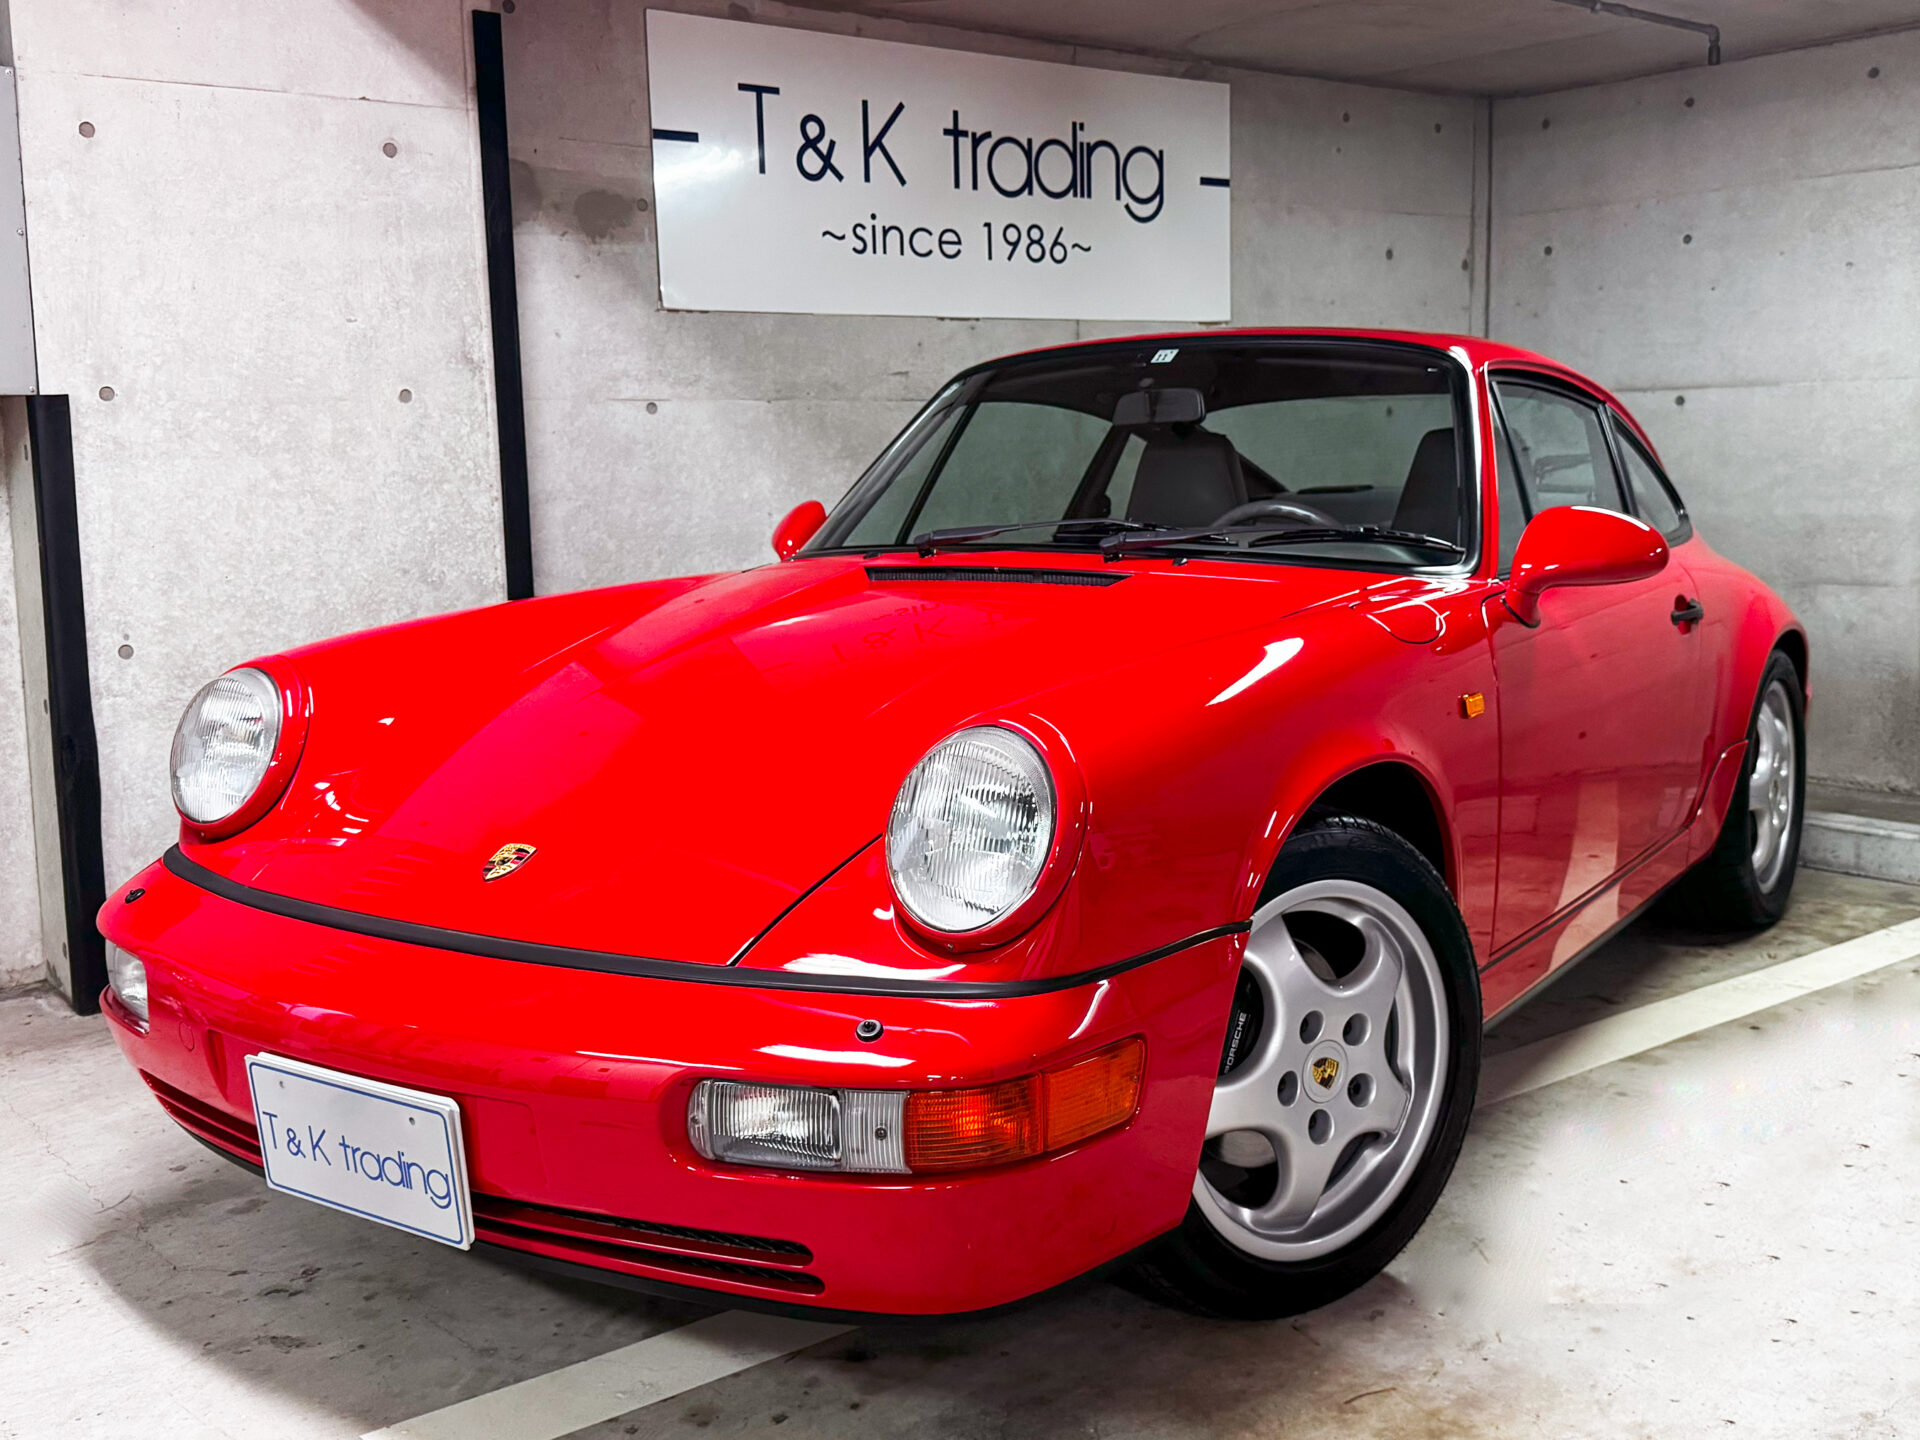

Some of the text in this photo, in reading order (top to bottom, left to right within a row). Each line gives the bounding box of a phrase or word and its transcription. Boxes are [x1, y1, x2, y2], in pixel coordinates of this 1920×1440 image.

[737, 83, 1165, 224] T & K trading
[262, 1111, 452, 1210] T & K trading
